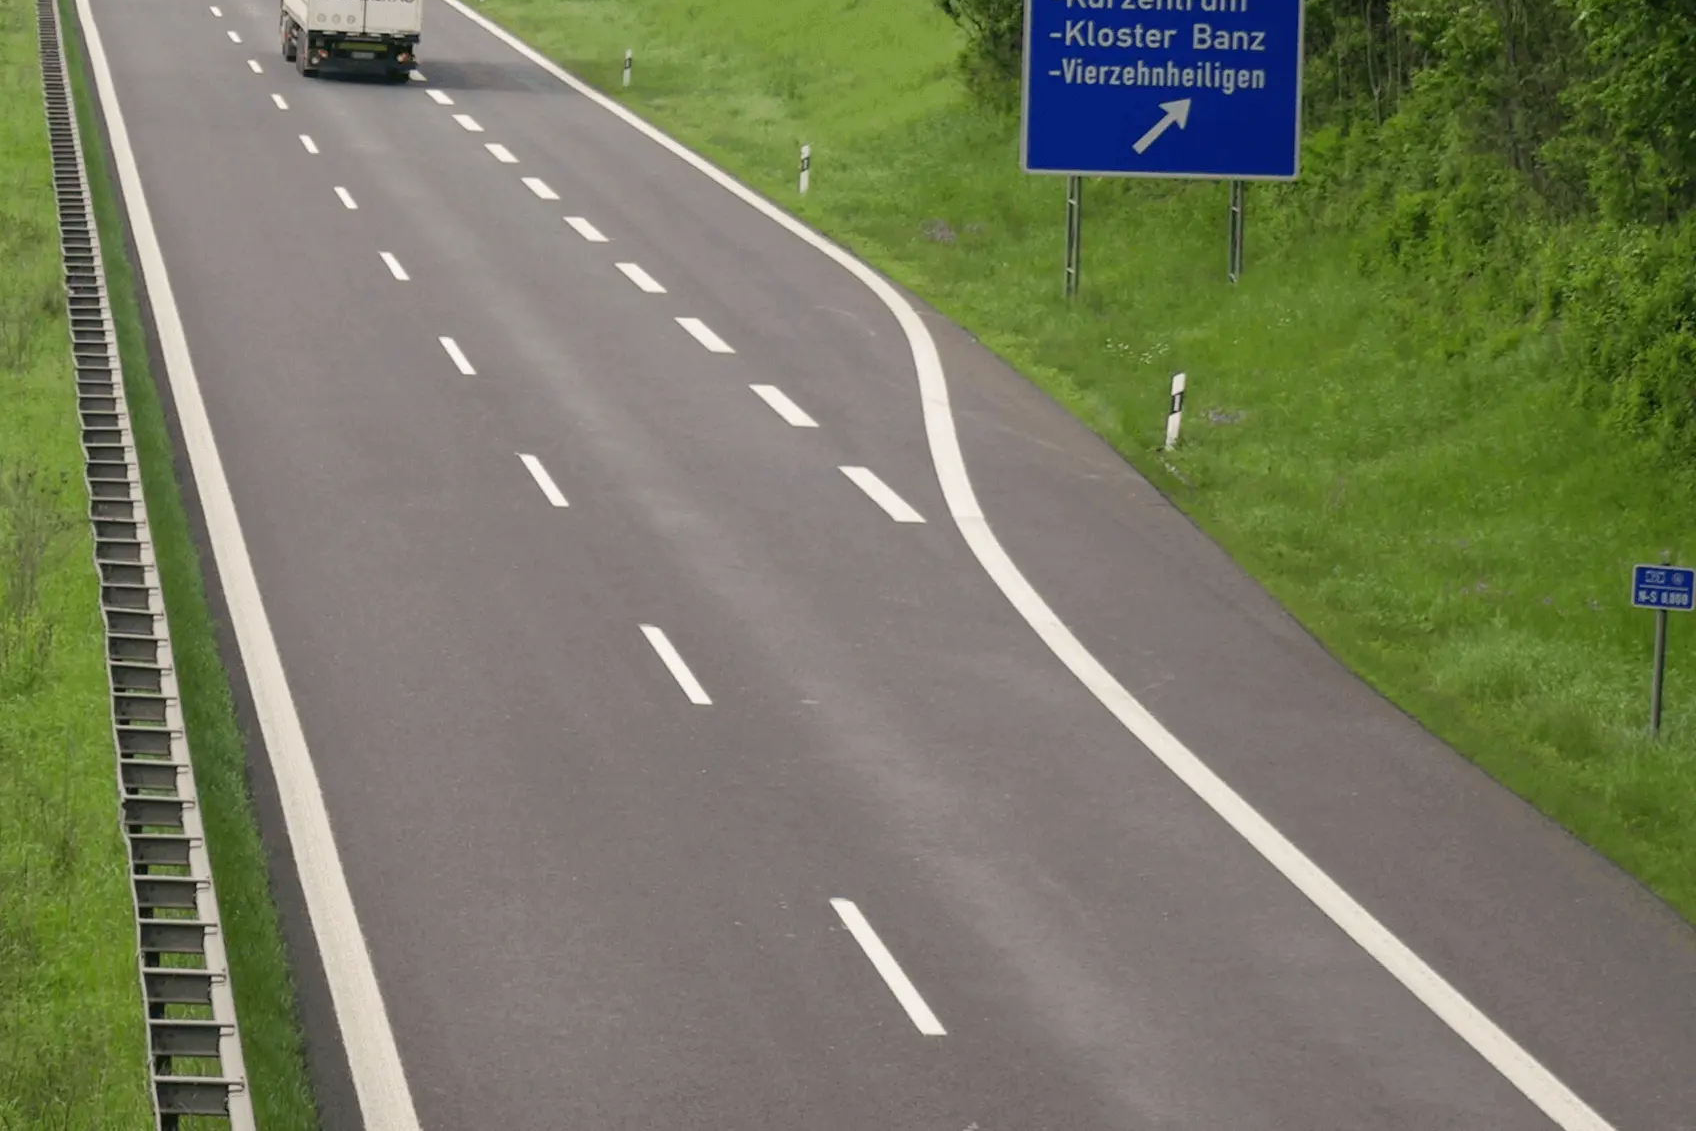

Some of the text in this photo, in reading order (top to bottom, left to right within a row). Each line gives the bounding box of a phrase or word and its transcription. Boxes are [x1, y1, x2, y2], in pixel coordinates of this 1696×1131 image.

[1049, 20, 1266, 52] -Kloster Banz
[1048, 57, 1266, 95] -Vierzehnheiligen
